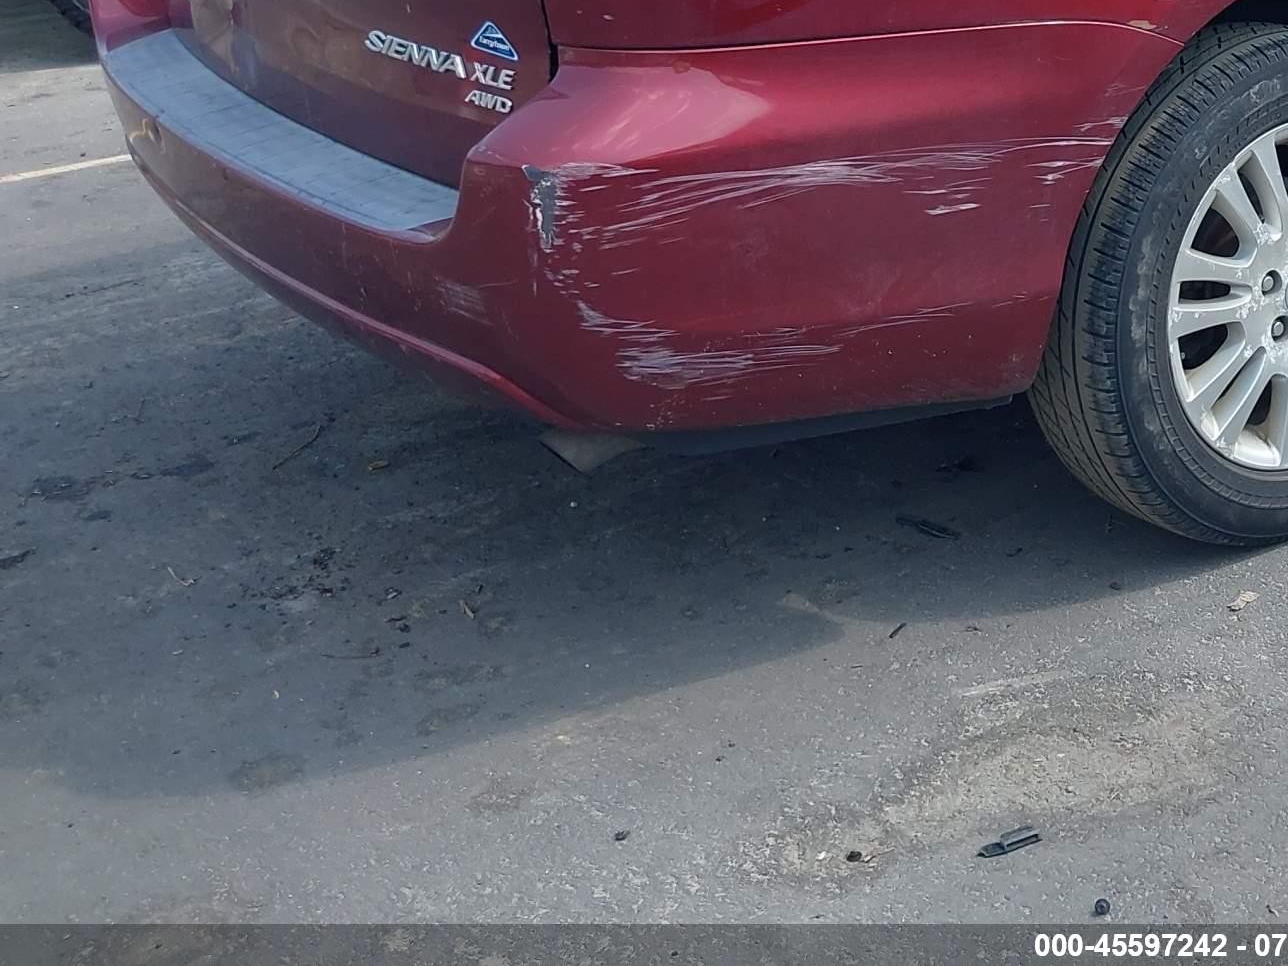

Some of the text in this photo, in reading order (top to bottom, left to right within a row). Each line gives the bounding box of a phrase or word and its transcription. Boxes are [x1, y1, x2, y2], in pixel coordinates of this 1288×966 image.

[364, 30, 516, 90] SIENNA XLE
[464, 89, 513, 114] AWD
